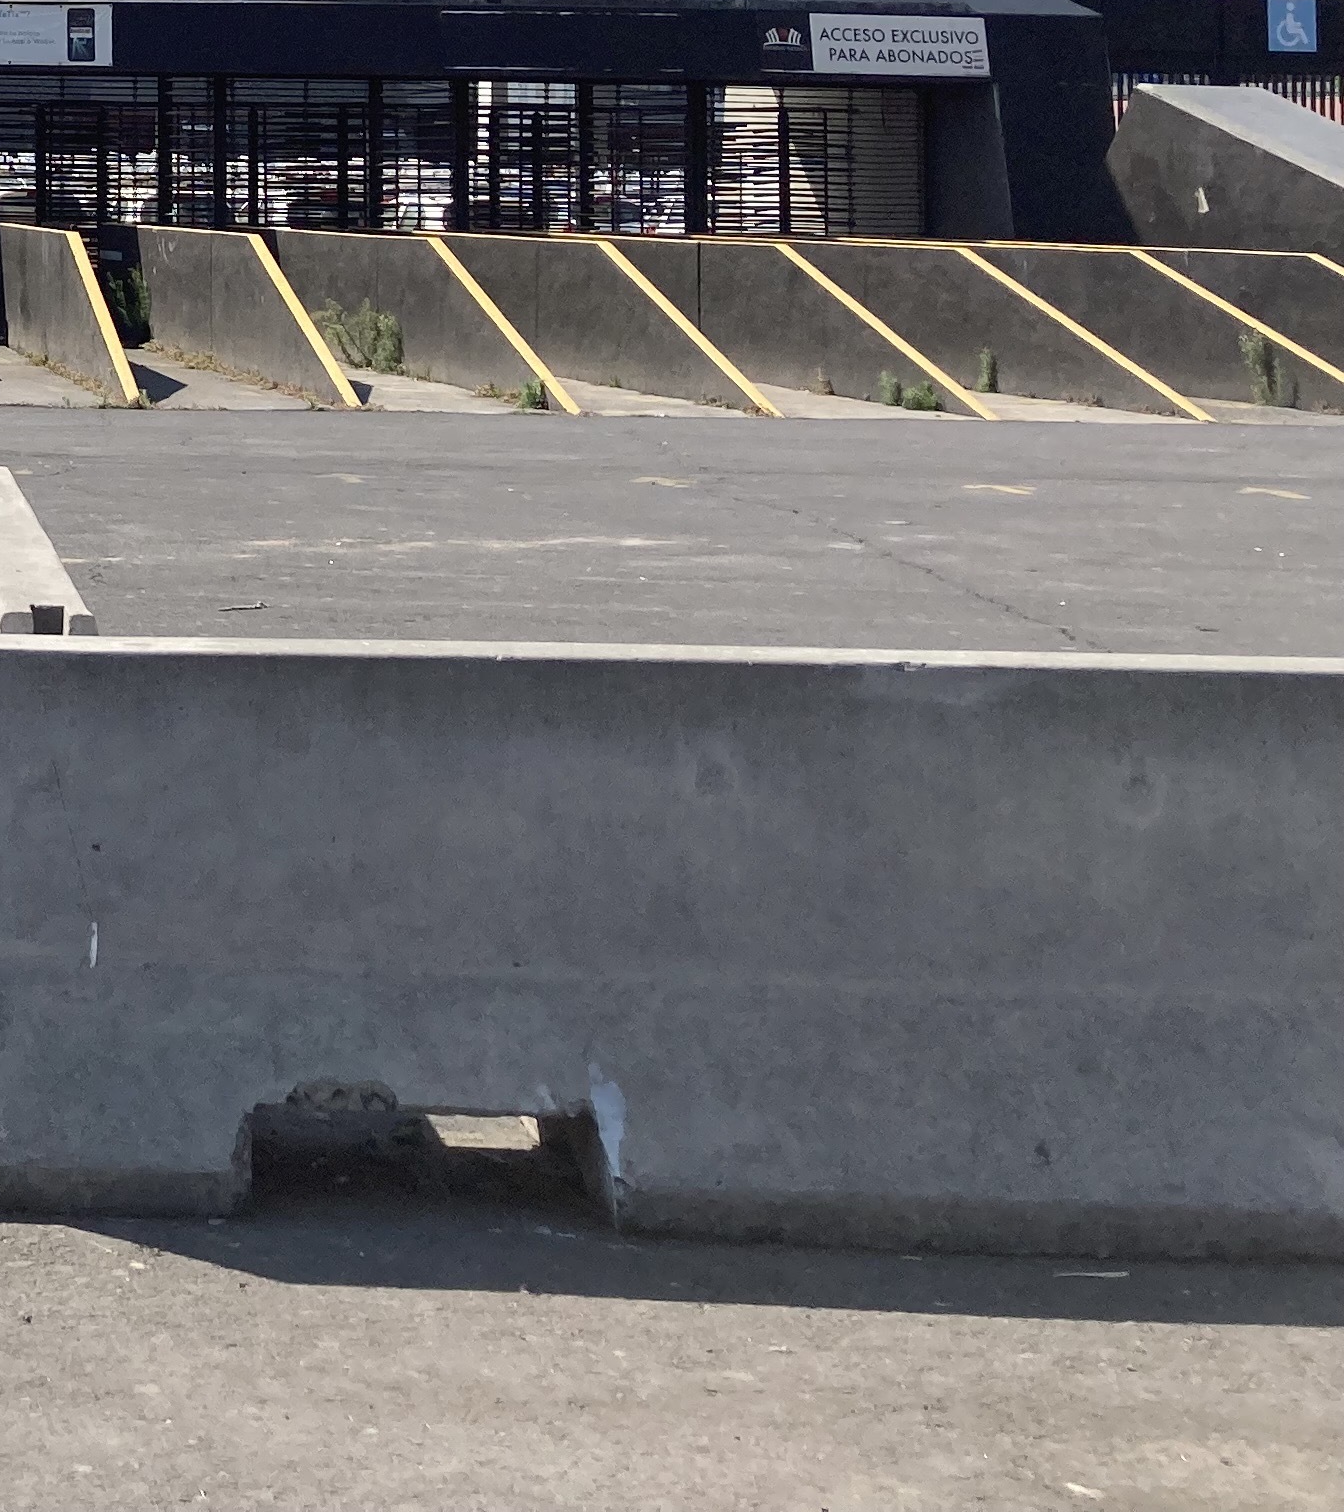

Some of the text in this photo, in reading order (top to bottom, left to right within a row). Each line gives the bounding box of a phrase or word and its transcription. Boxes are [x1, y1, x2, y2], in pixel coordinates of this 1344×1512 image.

[819, 27, 979, 45] ACCESO EXCLUSIVO
[829, 47, 972, 65] PARA ABONADOS
